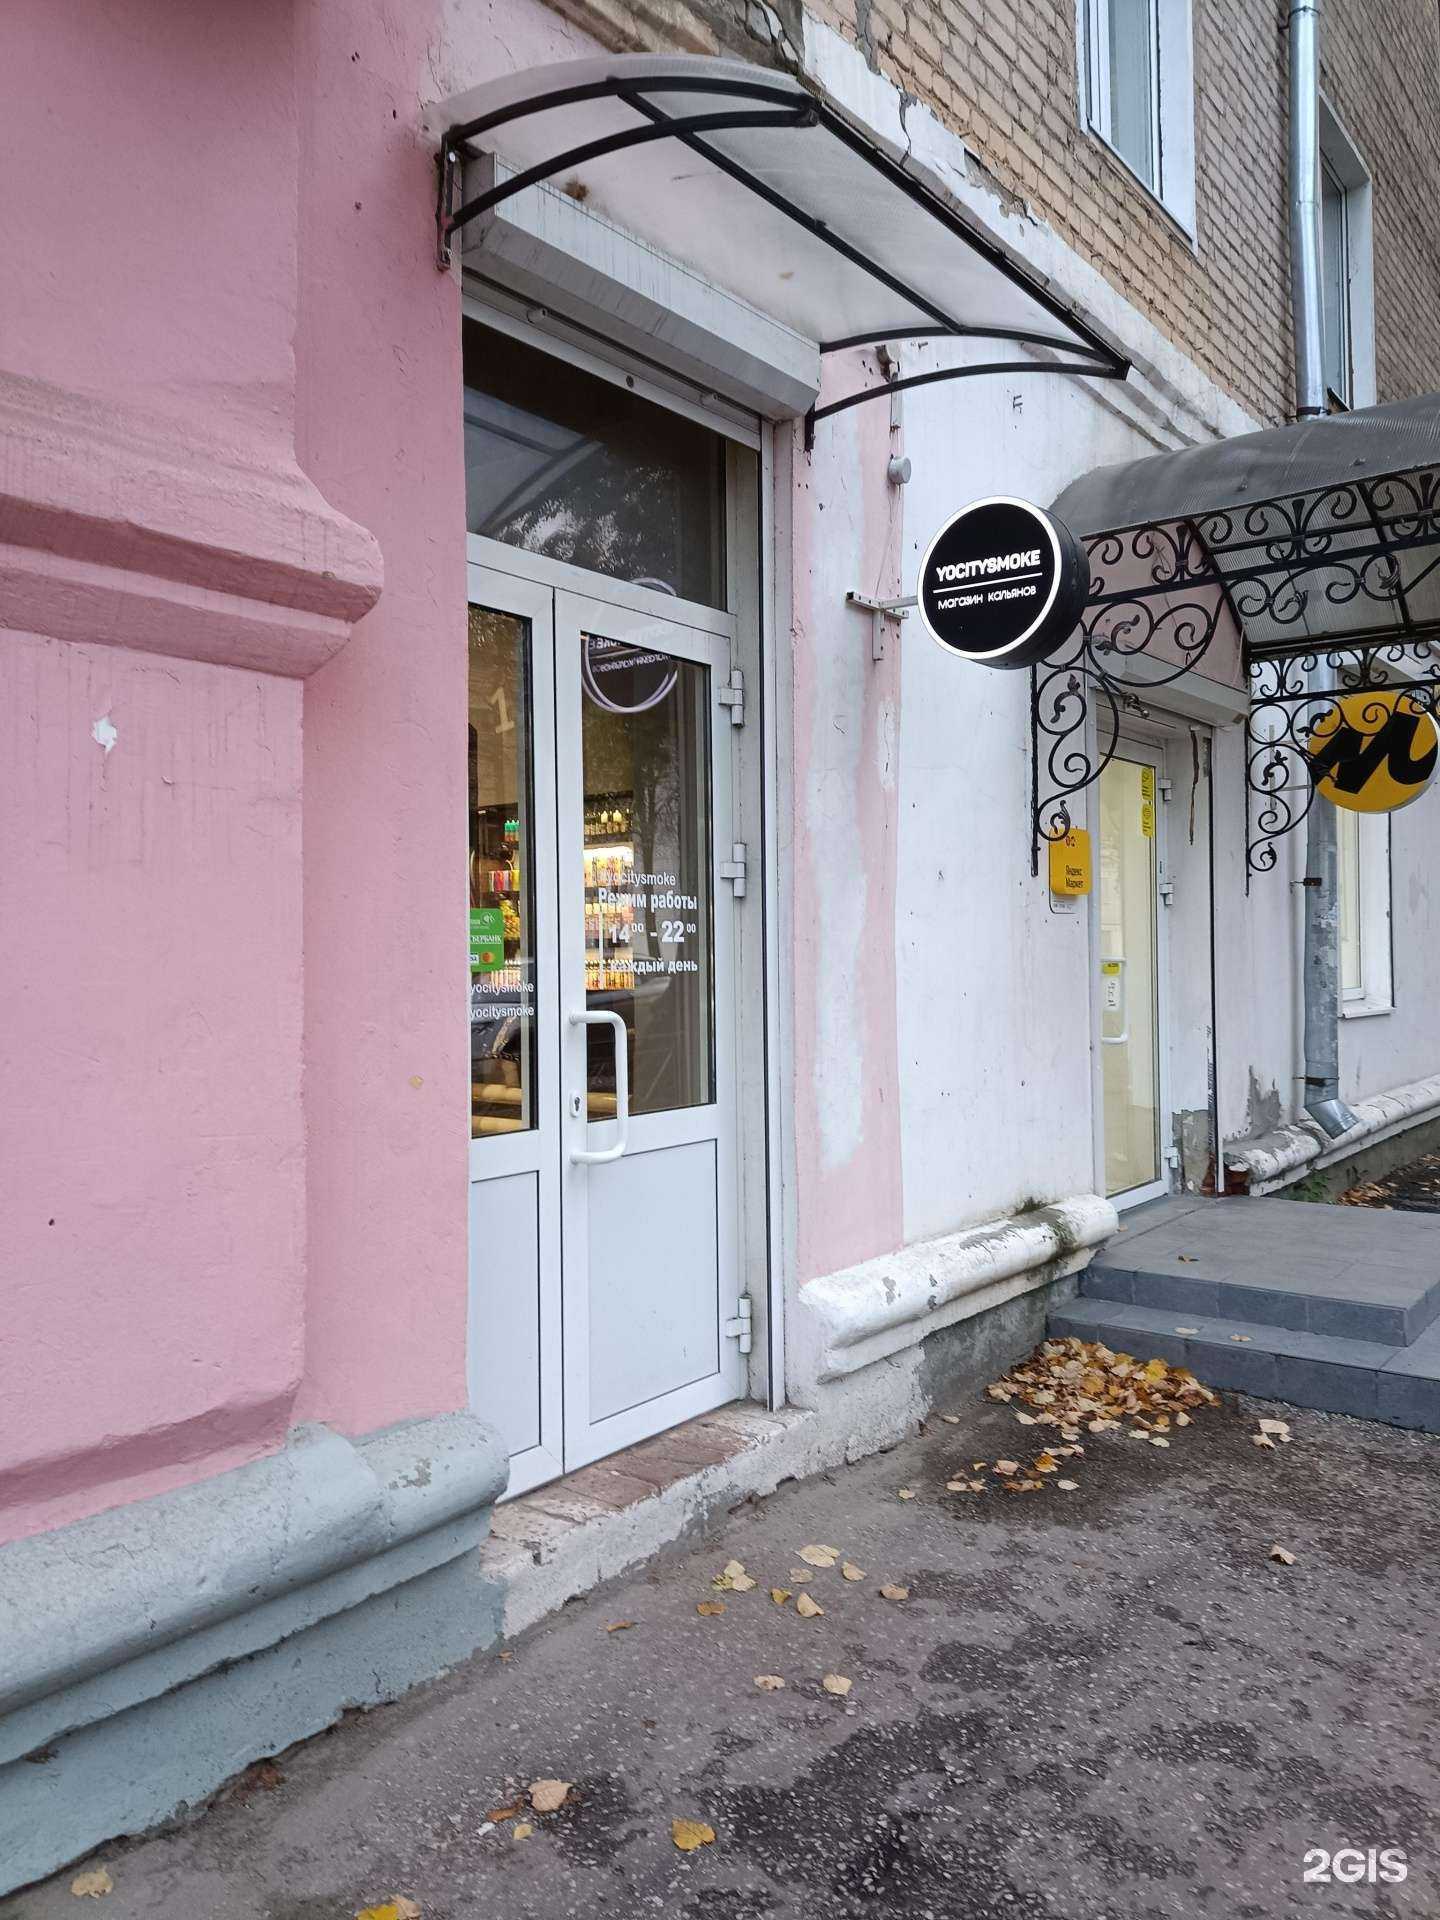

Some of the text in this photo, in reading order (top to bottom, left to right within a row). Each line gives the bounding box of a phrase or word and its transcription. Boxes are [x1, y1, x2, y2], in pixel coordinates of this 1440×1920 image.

[936, 549, 1041, 582] YOCITYSMOKE
[938, 585, 1037, 610] магазин кальянов
[599, 888, 697, 912] Режим работы
[610, 957, 698, 975] каждый день
